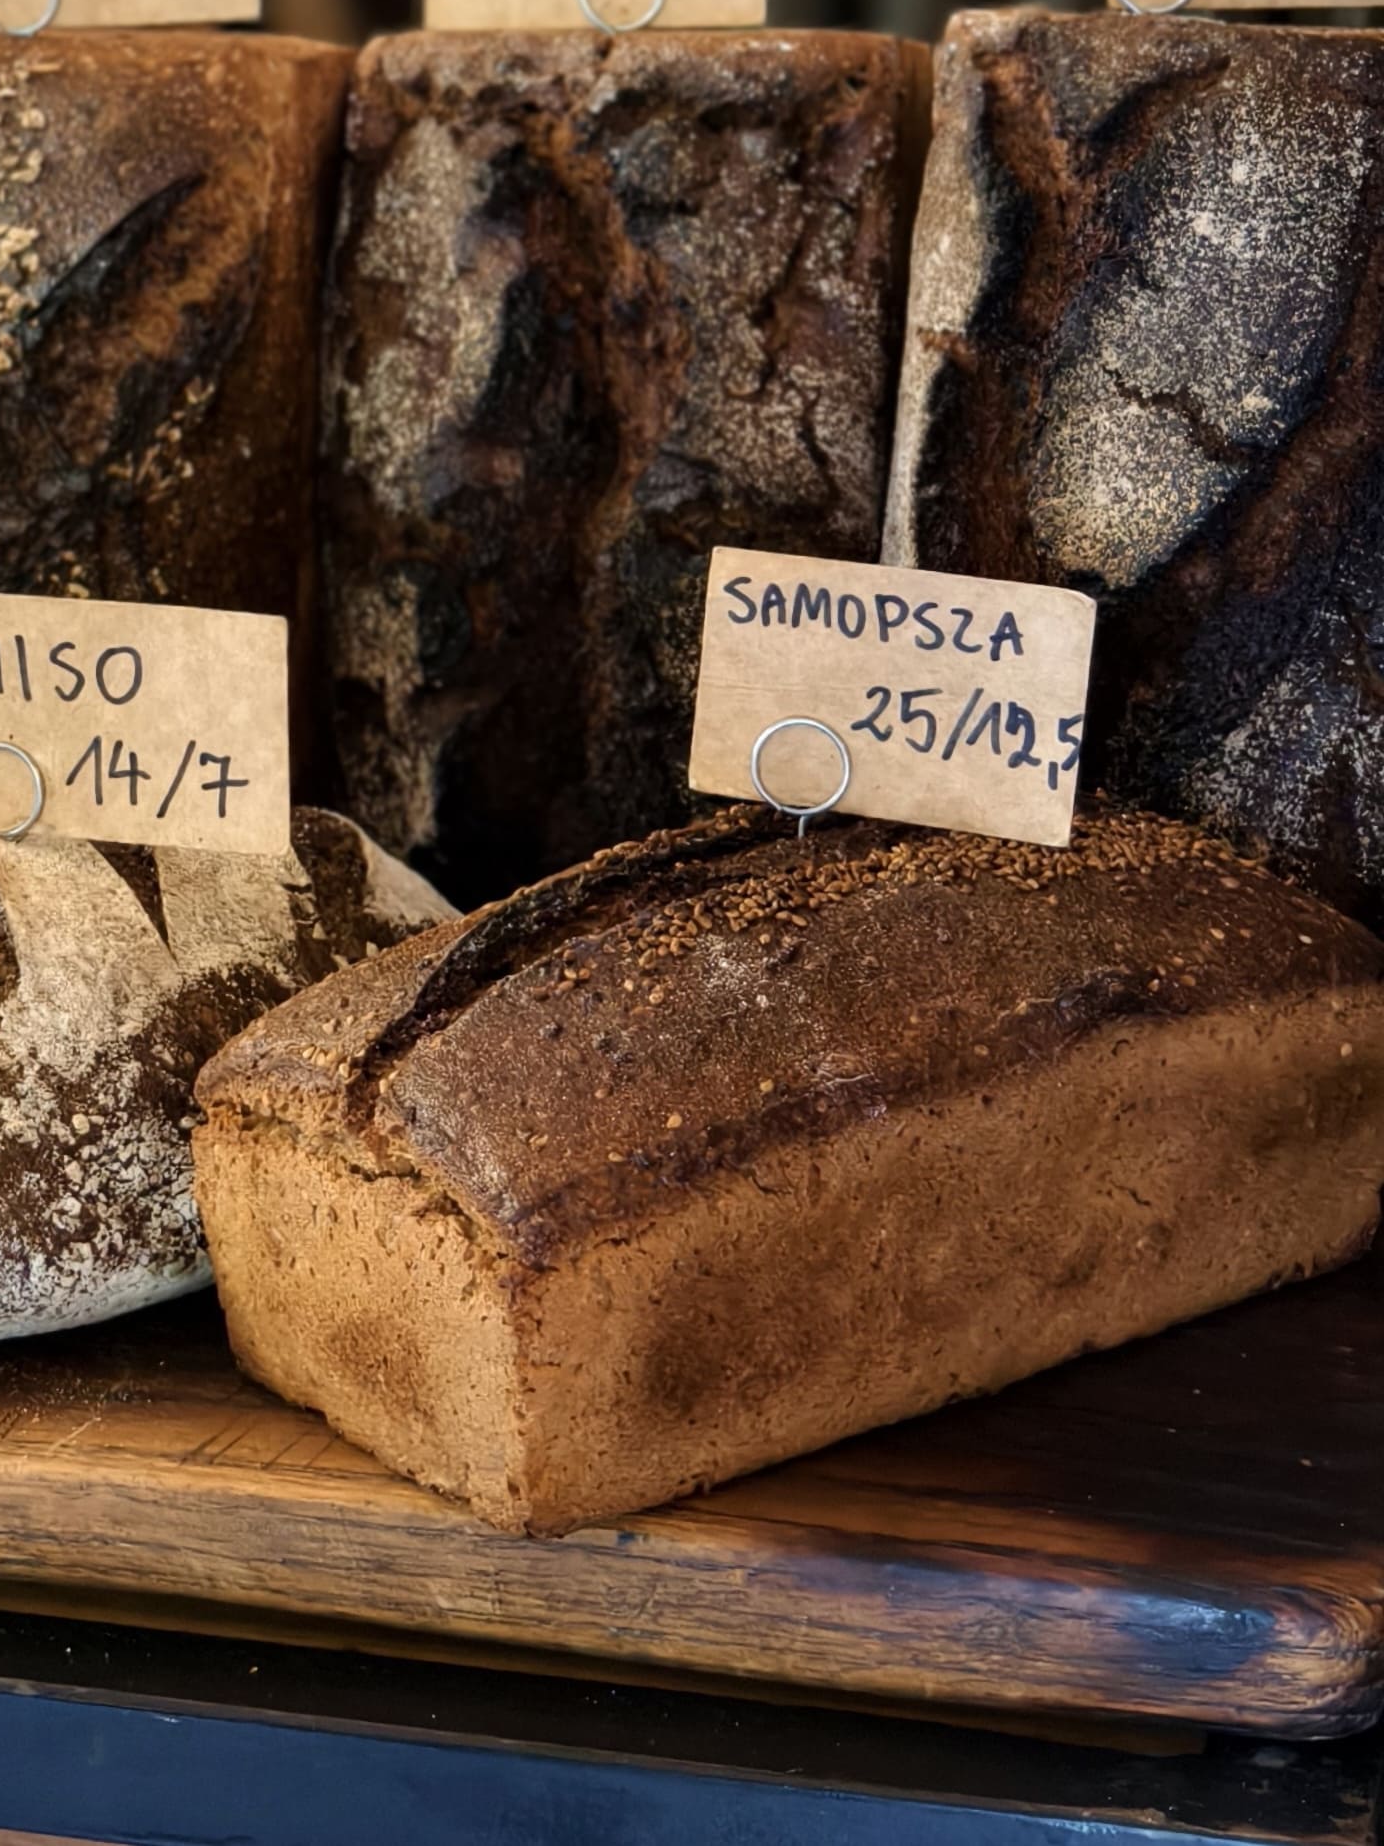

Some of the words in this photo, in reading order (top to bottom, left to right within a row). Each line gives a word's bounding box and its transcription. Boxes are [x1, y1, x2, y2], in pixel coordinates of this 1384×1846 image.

[723, 576, 1025, 662] SAMOPSZA
[65, 735, 250, 819] 14/7
[850, 685, 1085, 791] 25/12,5
